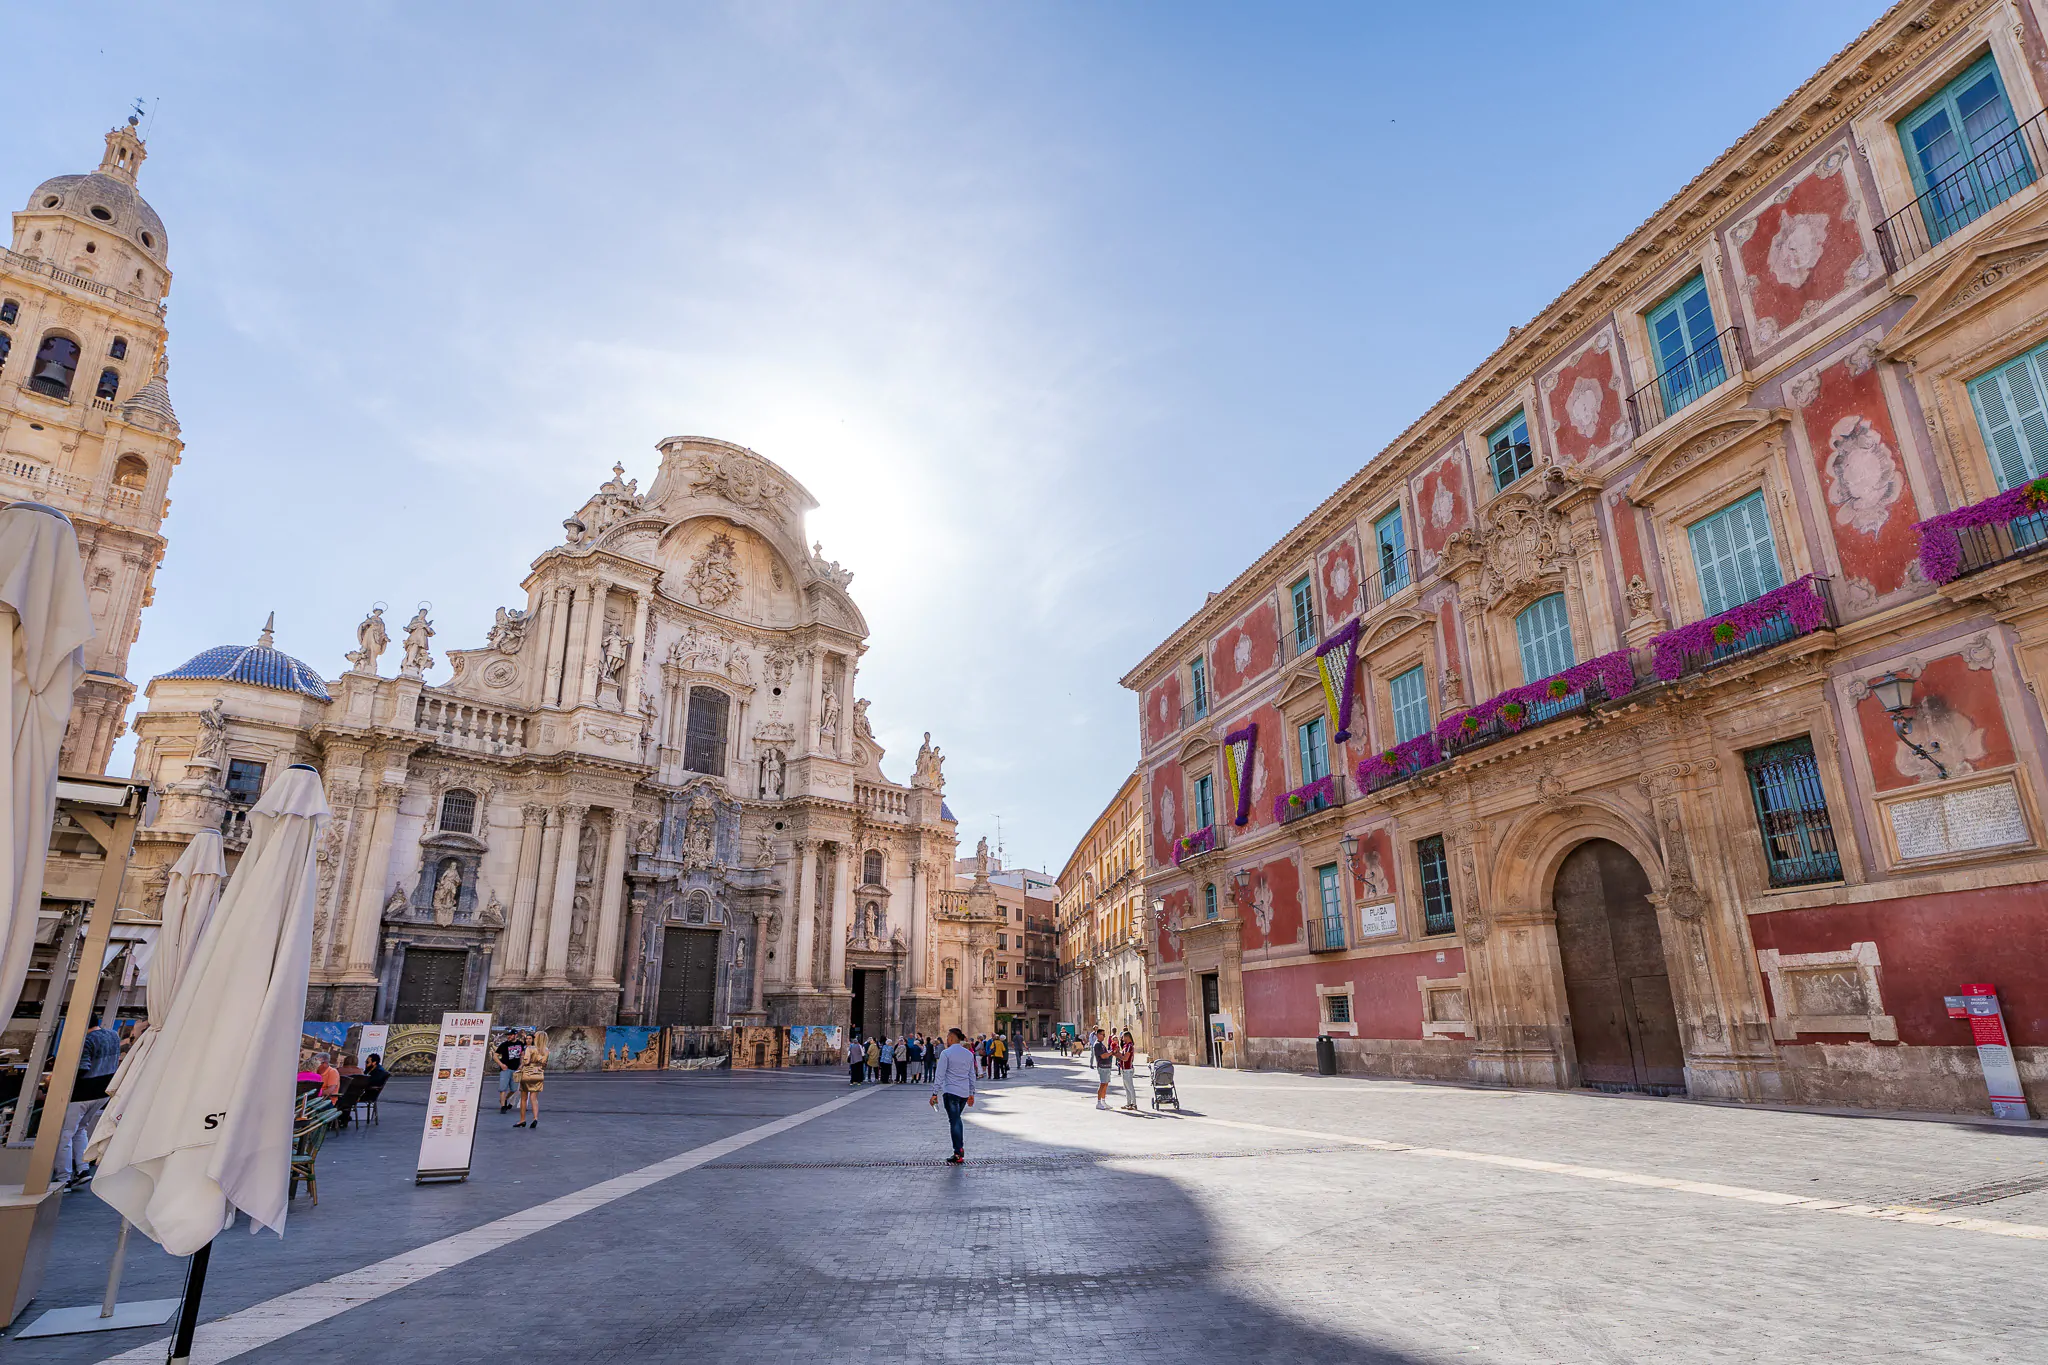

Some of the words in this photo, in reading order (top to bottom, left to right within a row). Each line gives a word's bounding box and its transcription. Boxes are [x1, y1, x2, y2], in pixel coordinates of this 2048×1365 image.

[1370, 906, 1388, 916] PLAZA
[450, 1018, 459, 1027] LA
[459, 1018, 485, 1027] CARMEN
